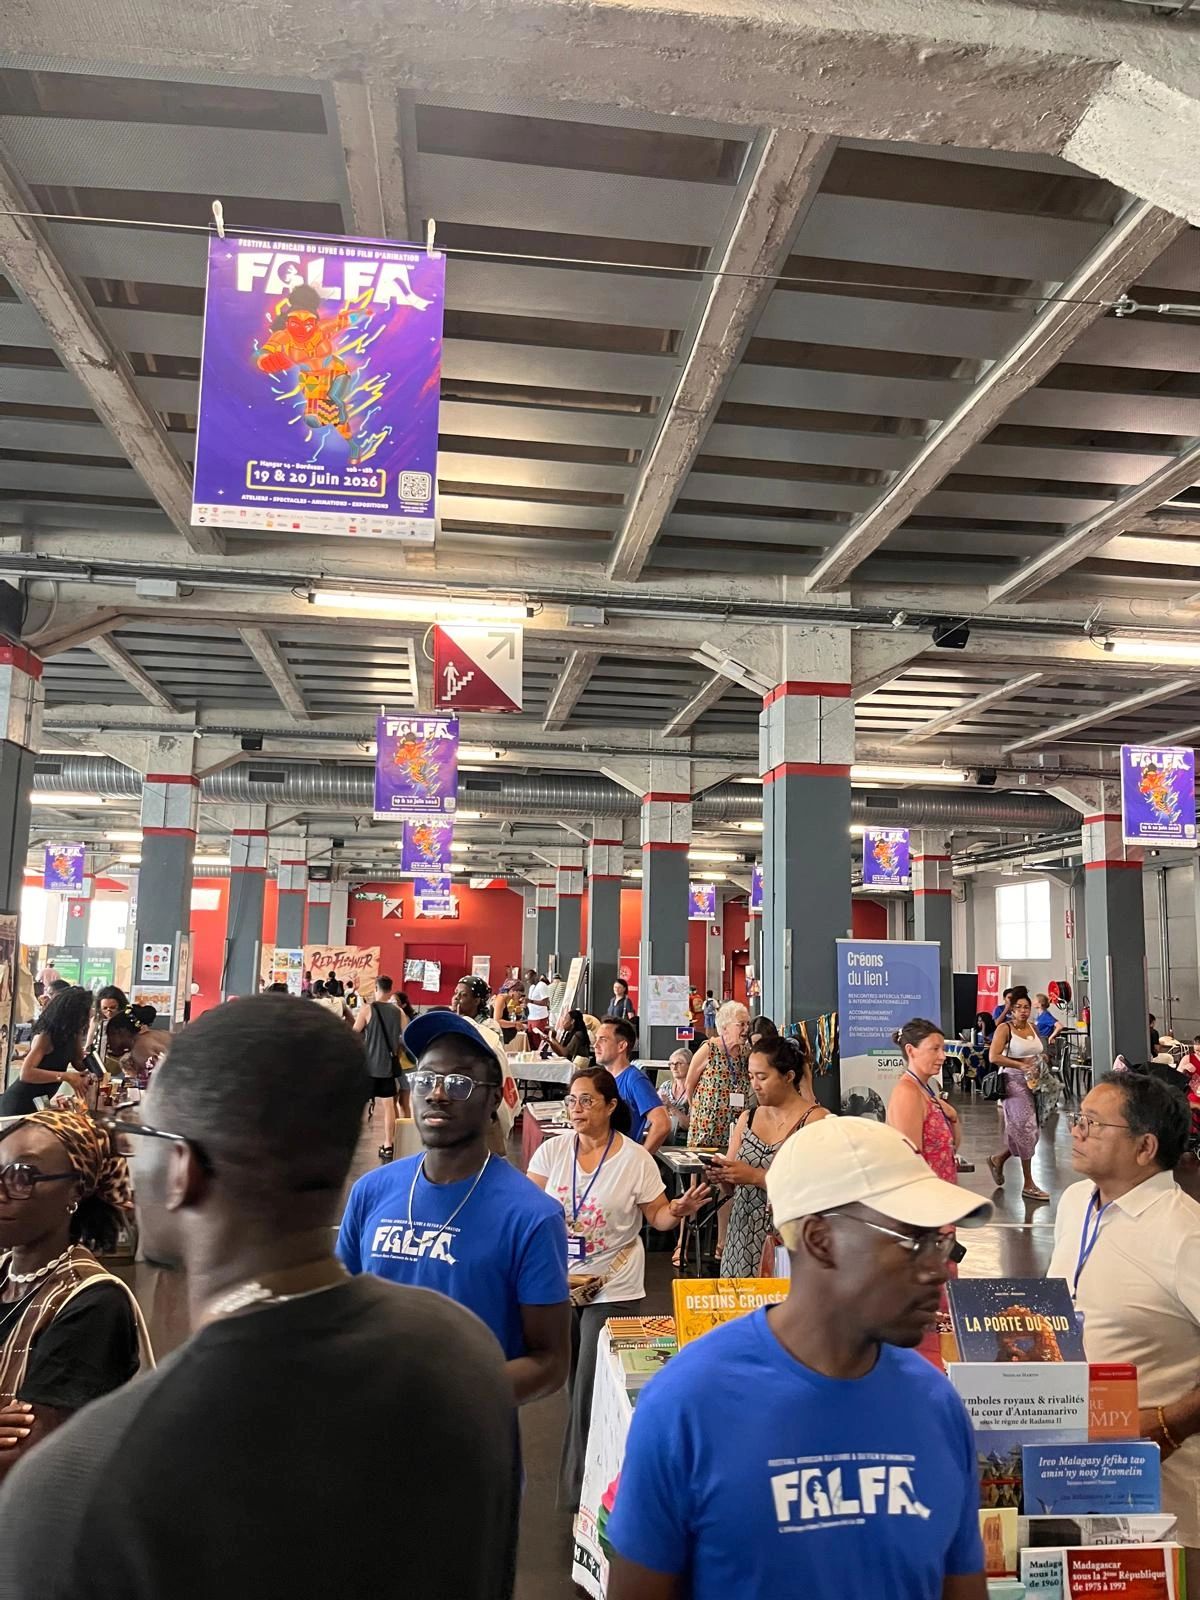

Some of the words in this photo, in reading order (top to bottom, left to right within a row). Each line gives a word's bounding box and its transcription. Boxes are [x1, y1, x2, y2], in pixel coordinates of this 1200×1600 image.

[236, 252, 434, 311] FALFA
[253, 470, 270, 483] 19
[273, 469, 286, 482] &
[289, 472, 307, 483] 20
[309, 471, 340, 487] juin
[343, 475, 378, 488] 2026
[386, 721, 456, 740] FALFA
[847, 951, 884, 967] Créons
[848, 970, 861, 986] du
[864, 970, 883, 986] lien
[885, 971, 889, 986] !
[371, 1226, 456, 1265] FALFA
[685, 1294, 736, 1310] DESTINS
[965, 1316, 982, 1332] LA
[983, 1316, 1022, 1332] PORTE
[1024, 1316, 1042, 1331] DU
[1043, 1315, 1070, 1331] SUD
[963, 1395, 1001, 1405] mboles
[1003, 1397, 1035, 1407] royaux
[1037, 1395, 1046, 1405] &
[1047, 1394, 1085, 1405] rivalités
[1089, 1399, 1104, 1410] RE
[971, 1407, 980, 1417] la
[981, 1409, 1003, 1417] cour
[1005, 1406, 1078, 1417] d'Antananarivo
[1090, 1410, 1132, 1427] MPY
[1039, 1456, 1056, 1467] Ireo
[1058, 1455, 1102, 1467] Malagasy
[1130, 1456, 1146, 1464] tao
[1079, 1469, 1099, 1479] nosy
[1101, 1466, 1143, 1477] Tromelin
[770, 1465, 931, 1520] FALFA
[1029, 1560, 1063, 1570] Madaga
[1072, 1560, 1122, 1571] Madagascar
[1049, 1569, 1058, 1577] la
[1092, 1571, 1101, 1579] la
[1118, 1568, 1167, 1581] République
[1029, 1580, 1041, 1588] de
[1041, 1579, 1060, 1587] 1960
[1072, 1583, 1083, 1591] de
[1084, 1582, 1101, 1591] 1975
[1102, 1582, 1109, 1591] à
[1110, 1582, 1127, 1591] 1992
